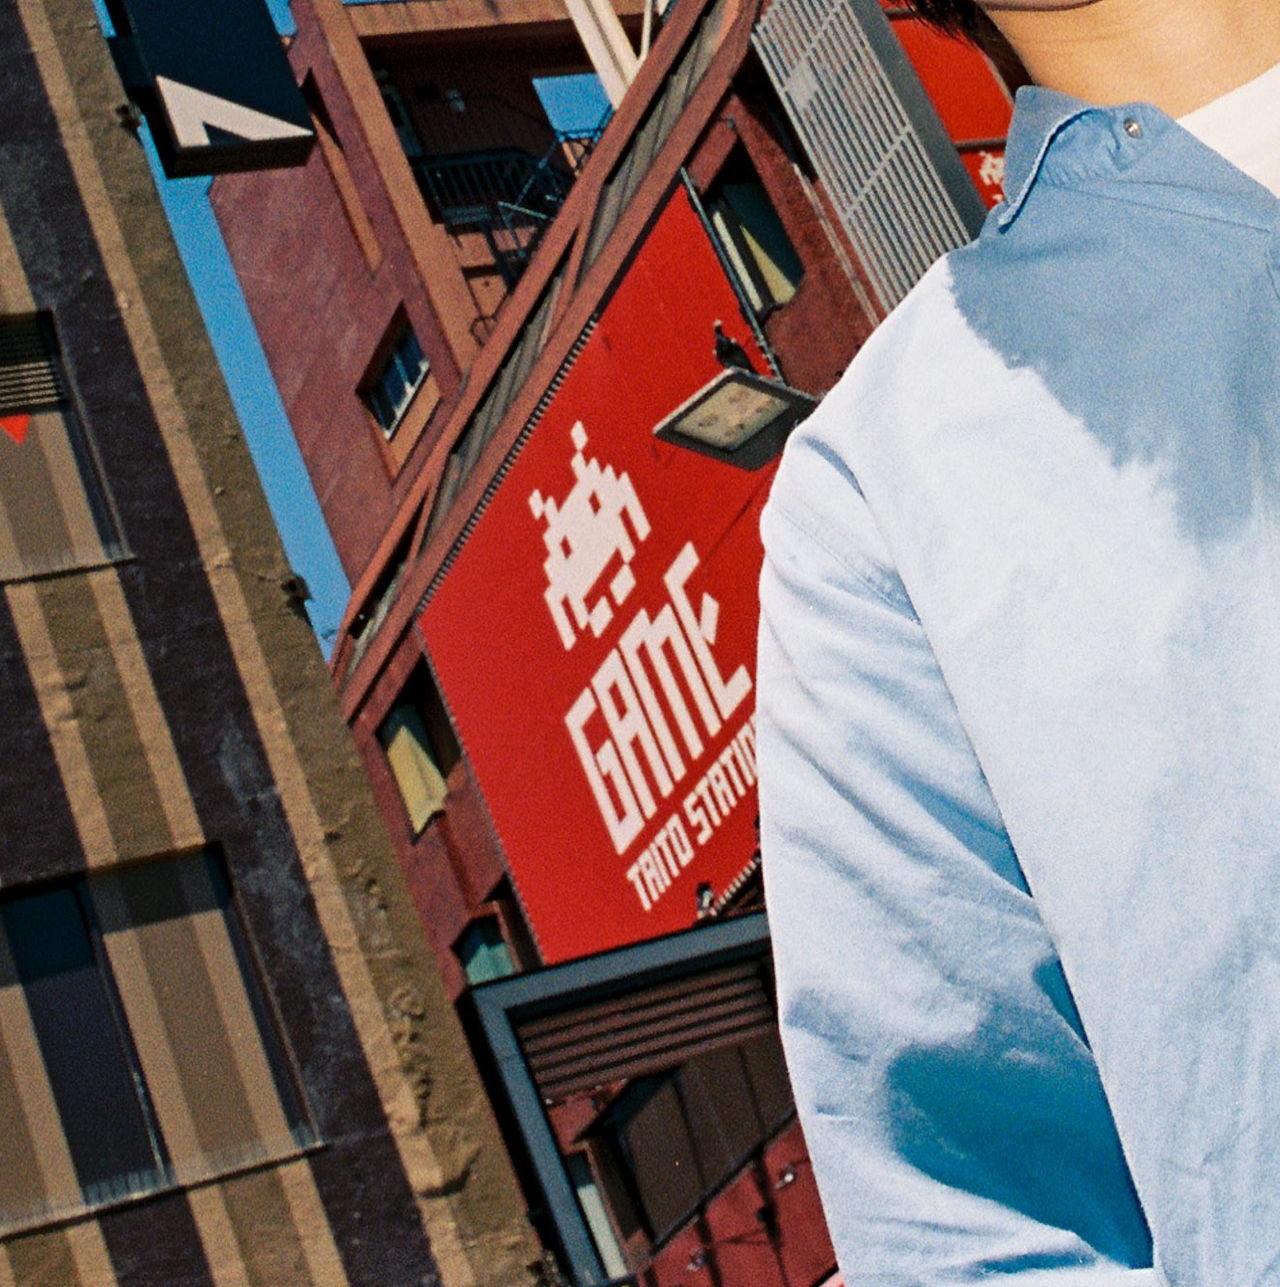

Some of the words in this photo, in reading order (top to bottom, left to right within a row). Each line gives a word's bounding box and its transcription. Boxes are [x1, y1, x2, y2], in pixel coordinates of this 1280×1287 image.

[565, 541, 752, 856] GAME
[626, 813, 695, 912] TAITO
[683, 710, 758, 846] STATIO
